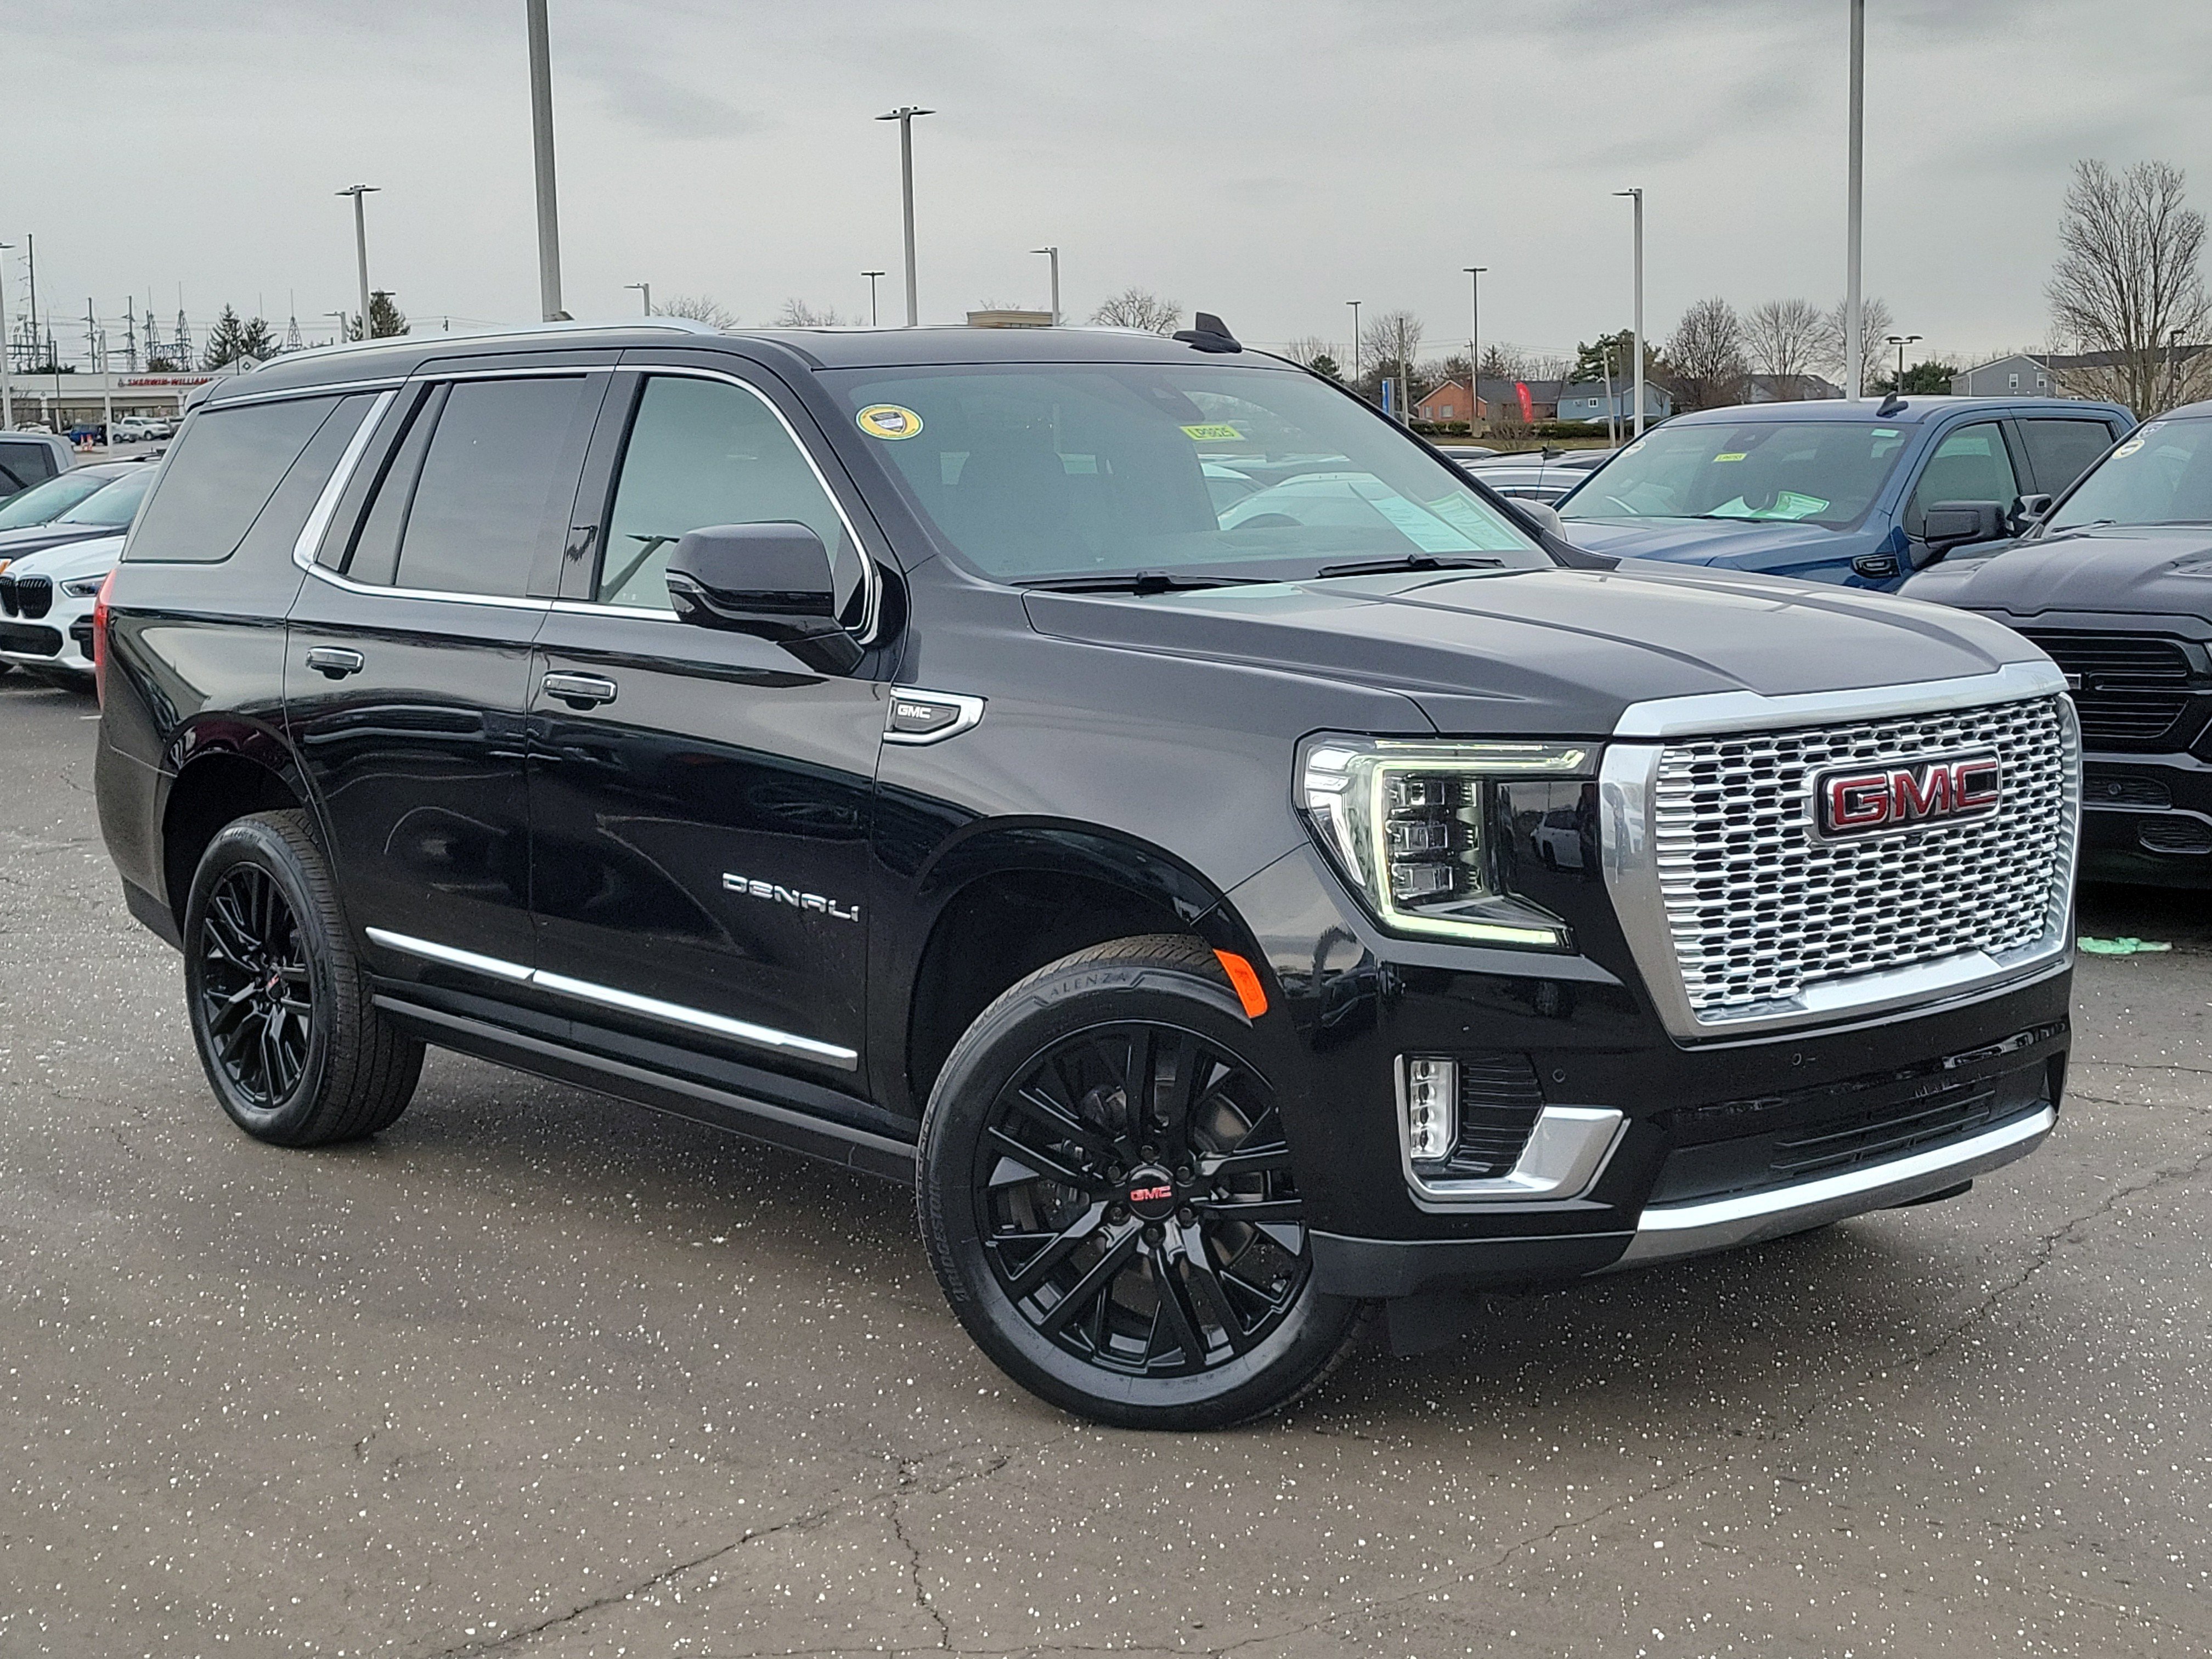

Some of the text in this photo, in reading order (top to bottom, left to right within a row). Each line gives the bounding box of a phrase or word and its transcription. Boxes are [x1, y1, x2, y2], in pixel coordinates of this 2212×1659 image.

[897, 704, 932, 719] GMC
[1826, 757, 1998, 831] GMC
[722, 872, 860, 923] DENALI
[1050, 972, 1127, 1000] ALENZA
[1130, 1185, 1172, 1201] GMC
[928, 1169, 971, 1302] BRIDGESTONE
